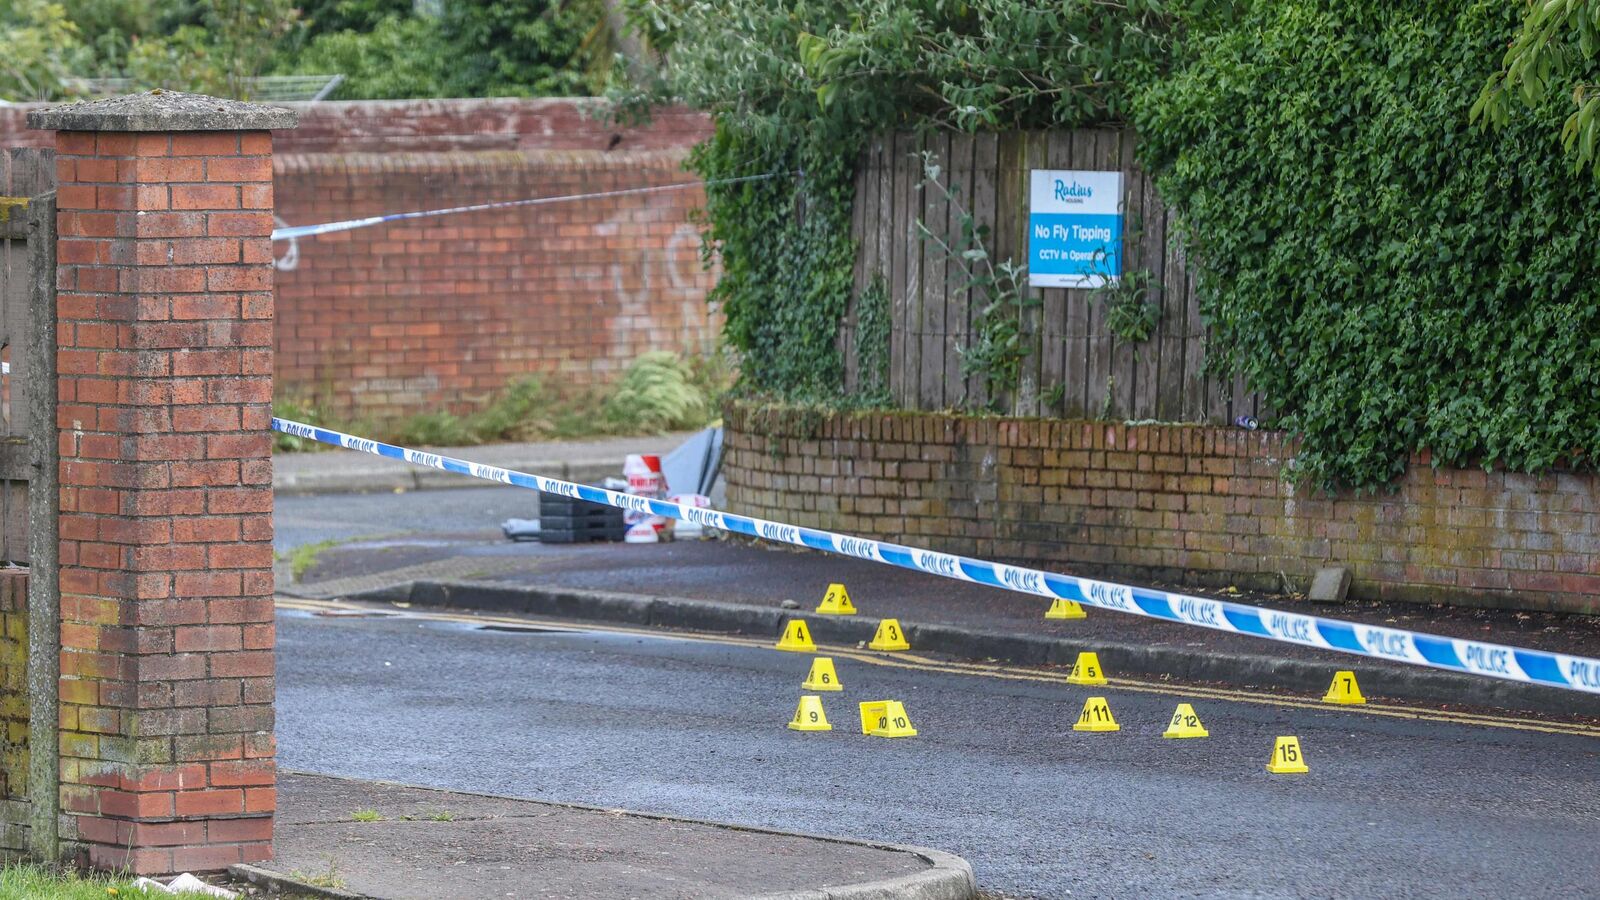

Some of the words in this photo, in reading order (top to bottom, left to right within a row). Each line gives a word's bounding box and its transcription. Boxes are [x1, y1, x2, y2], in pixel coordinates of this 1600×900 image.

[1055, 179, 1093, 202] Radius
[1034, 224, 1051, 239] No
[1053, 224, 1069, 241] Fly
[1072, 224, 1111, 242] Tipping
[1039, 249, 1060, 260] CCTV
[827, 592, 835, 602] 2
[841, 595, 848, 606] 2
[840, 537, 874, 559] POLICE
[920, 552, 955, 576] POLICE
[1004, 567, 1043, 594] POLICE
[1090, 582, 1130, 611] POLICE
[1180, 598, 1219, 627] POLICE
[1270, 613, 1312, 643] POLICE
[1366, 629, 1409, 659] POLICE
[1466, 645, 1510, 675] POLICE
[797, 627, 805, 642] 4
[888, 625, 898, 641] 3
[821, 673, 830, 684] 6
[1087, 666, 1096, 678] 5
[1343, 678, 1351, 694] 7
[809, 711, 819, 723] 9
[1082, 708, 1090, 723] 11
[1093, 704, 1110, 722] 11
[1173, 713, 1182, 726] 12
[878, 716, 887, 729] 10
[892, 716, 906, 729] 10
[1184, 715, 1197, 728] 12
[1279, 743, 1297, 762] 15
